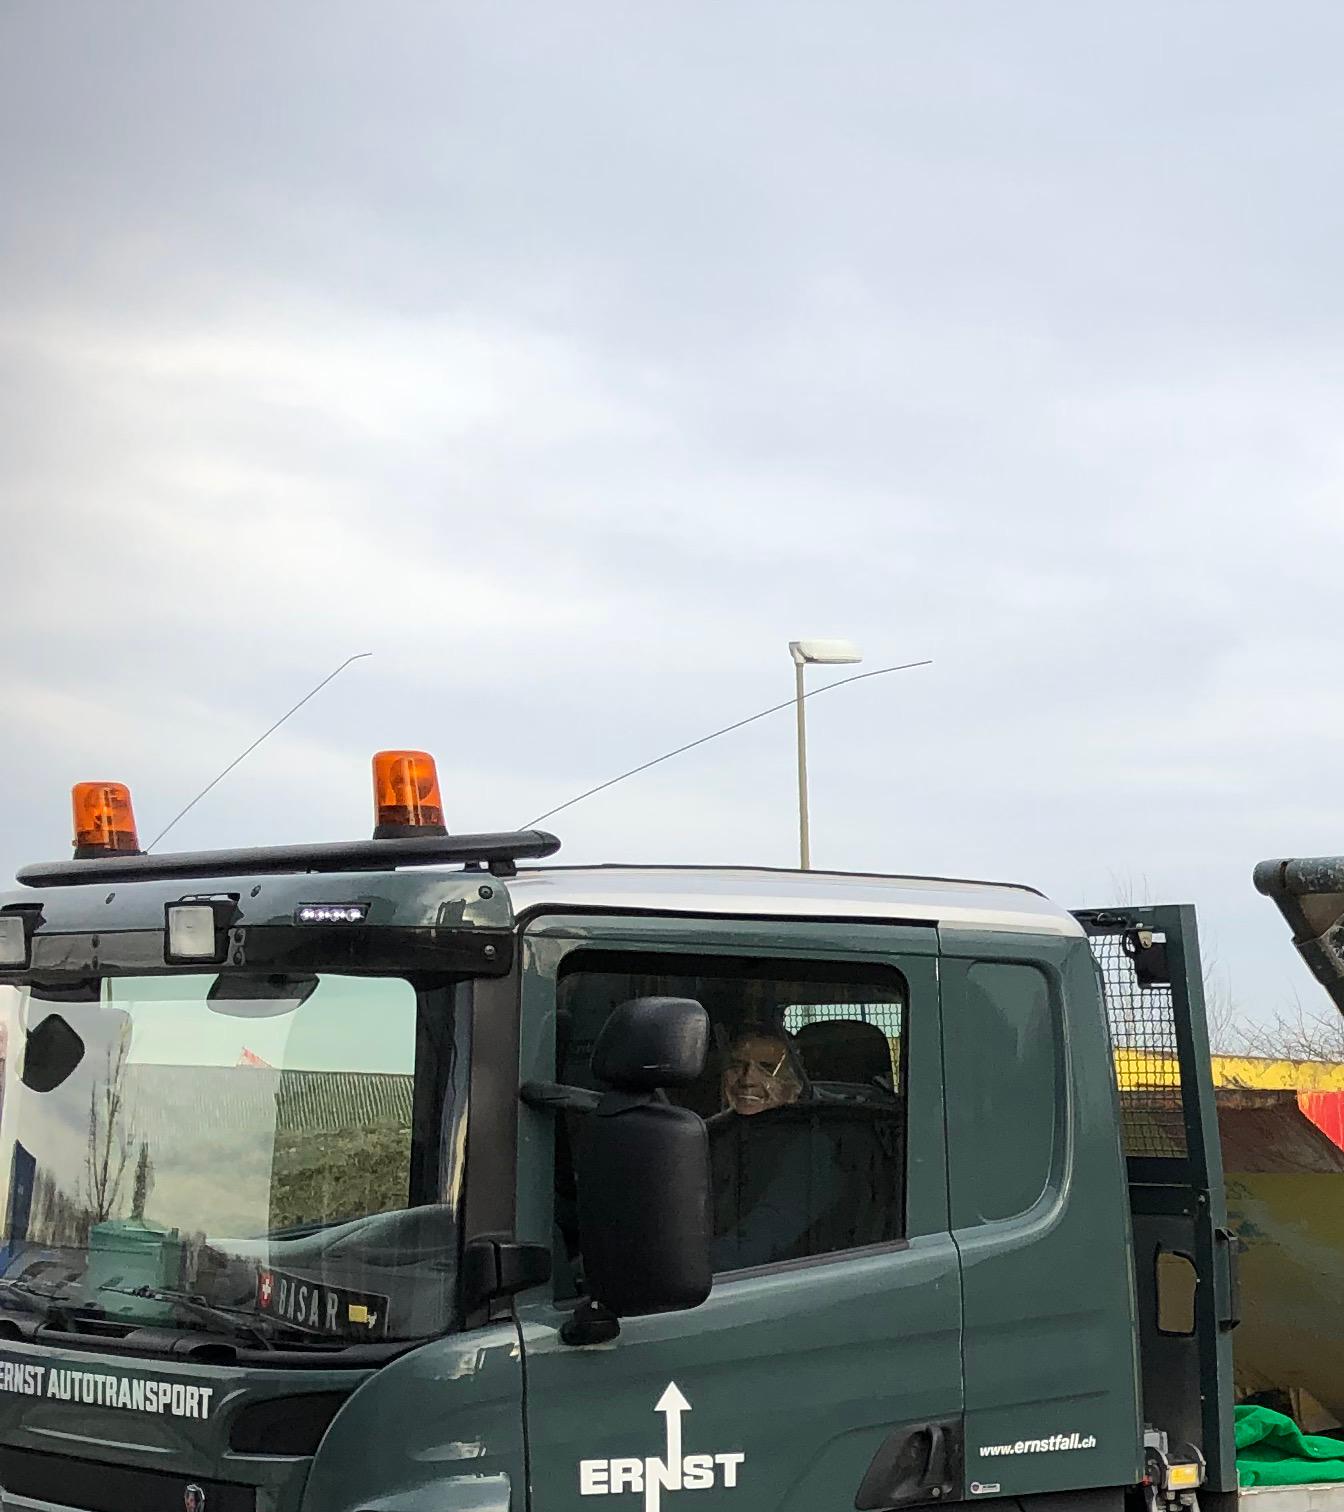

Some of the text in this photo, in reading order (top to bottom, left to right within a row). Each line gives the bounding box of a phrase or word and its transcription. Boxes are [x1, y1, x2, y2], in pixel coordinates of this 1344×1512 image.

[278, 1278, 340, 1331] BASAR
[46, 1368, 213, 1419] AUTOTRANSPORT
[979, 1432, 1097, 1457] www.ernstfall.ch
[579, 1451, 746, 1496] ERNST
